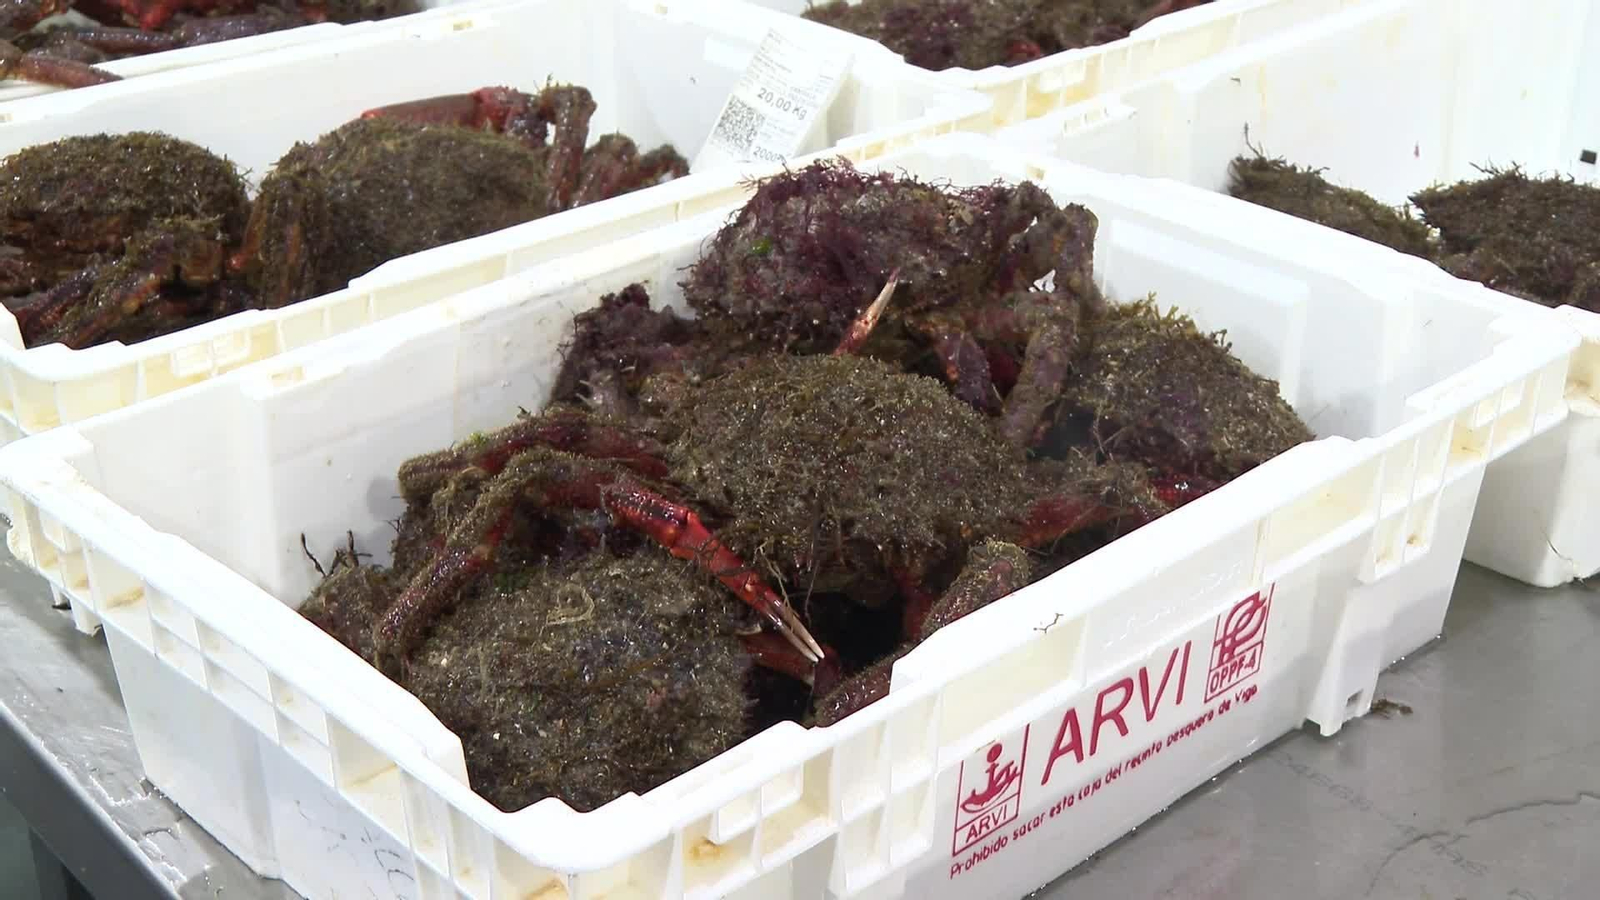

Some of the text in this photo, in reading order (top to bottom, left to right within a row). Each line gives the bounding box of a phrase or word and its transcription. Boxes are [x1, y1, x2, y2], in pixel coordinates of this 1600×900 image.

[757, 87, 792, 112] 20,00
[1041, 640, 1192, 786] ARVI
[950, 834, 1009, 880] Prohibido
[1012, 812, 1046, 841] sacar
[1049, 794, 1075, 818] esta
[1078, 777, 1102, 801] caja
[1105, 766, 1122, 784] del
[1125, 741, 1163, 771] recinto
[1218, 699, 1232, 716] de
[1235, 684, 1258, 705] Vigo
[966, 804, 1008, 844] ARVI
